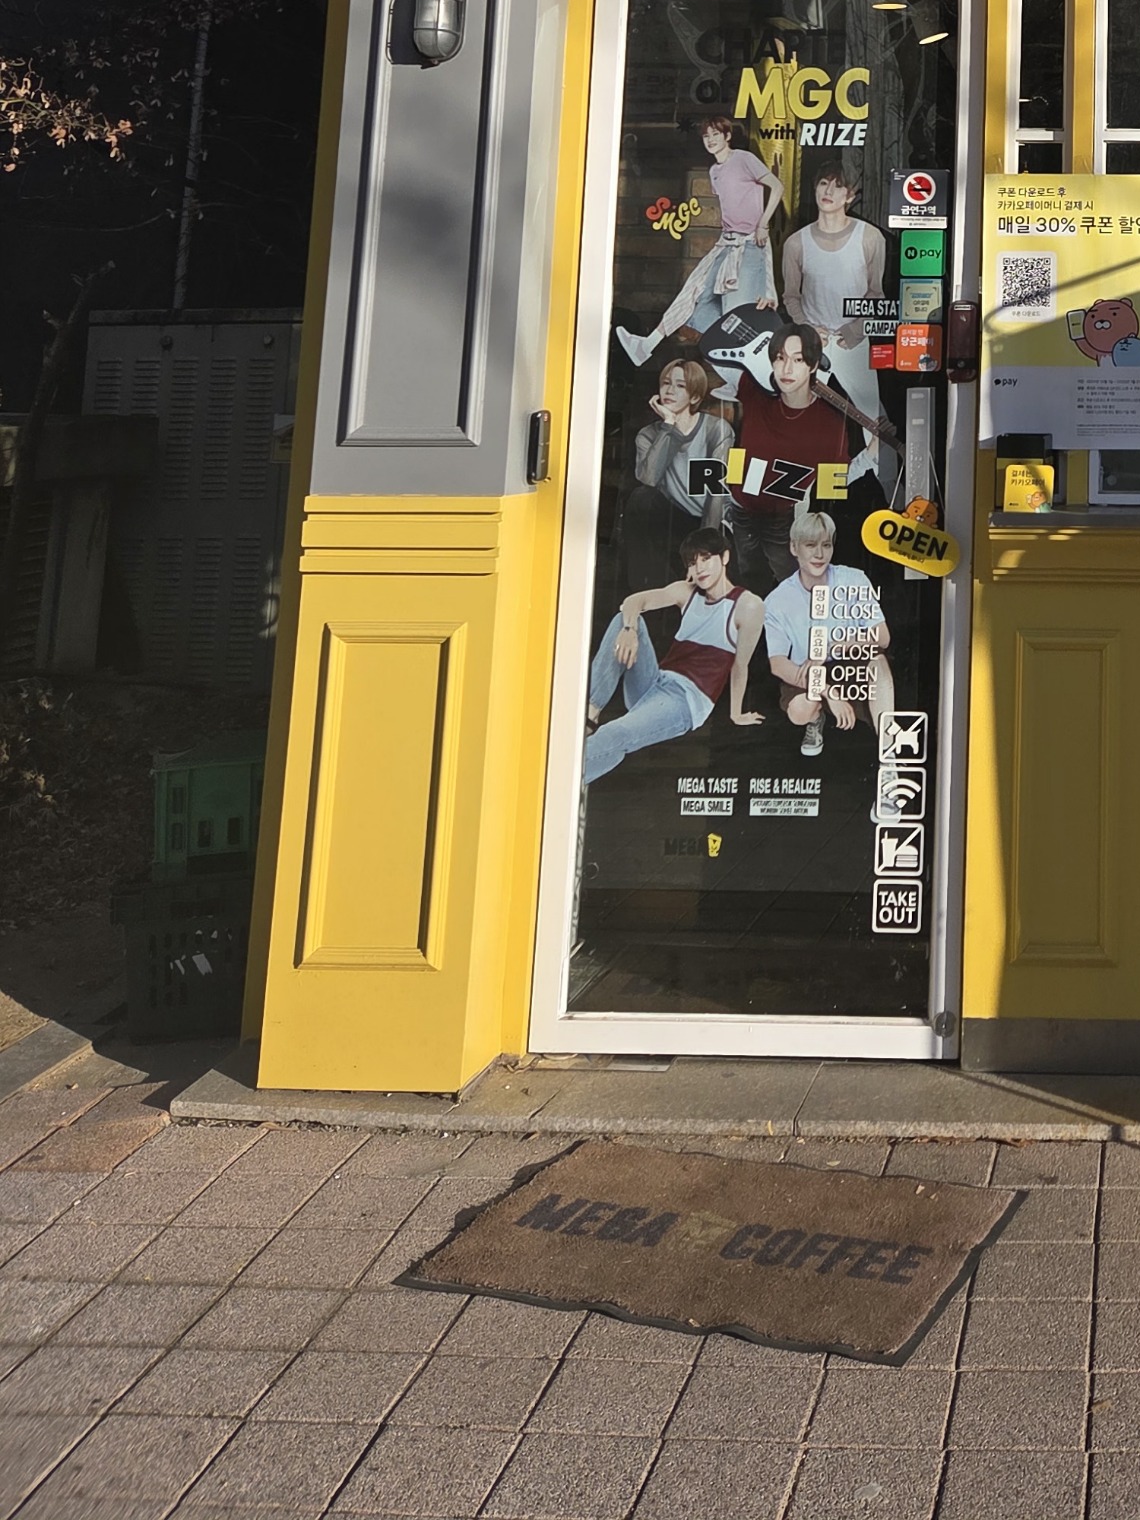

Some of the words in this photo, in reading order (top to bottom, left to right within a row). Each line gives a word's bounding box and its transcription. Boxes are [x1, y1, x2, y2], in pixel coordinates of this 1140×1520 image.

[734, 66, 871, 121] MGC
[759, 123, 796, 141] with
[799, 122, 868, 147] RIIZE
[997, 187, 1017, 197] 쿠폰
[1018, 187, 1055, 197] 다운로드
[1057, 186, 1067, 198] 후
[900, 205, 937, 216] 금연구역
[997, 200, 1062, 210] 카카오페이머니
[1064, 200, 1083, 211] 결제
[1084, 200, 1094, 210] 시
[998, 216, 1031, 234] 매일
[1035, 217, 1076, 233] 30%
[1079, 216, 1114, 234] 쿠폰
[919, 249, 942, 259] pay
[845, 299, 875, 316] MEGA
[1002, 378, 1018, 387] pay
[688, 448, 849, 501] RIIZE
[879, 519, 949, 561] OPEN
[833, 585, 881, 601] OPEN
[831, 603, 881, 619] CLOSE
[831, 626, 880, 642] OPEN
[830, 644, 879, 660] CLOSE
[831, 665, 878, 682] OPEN
[828, 684, 877, 701] CLOSE
[677, 777, 706, 794] MEGA
[707, 777, 738, 794] TASTE
[749, 778, 772, 794] RISE
[773, 778, 780, 794] &
[781, 778, 822, 795] REALIZE
[682, 800, 706, 813] MEGA
[707, 800, 731, 813] SMILE
[878, 891, 917, 907] TAKE
[878, 907, 917, 924] OUT
[515, 1193, 680, 1248] MEGA
[720, 1223, 934, 1285] COFFEE
